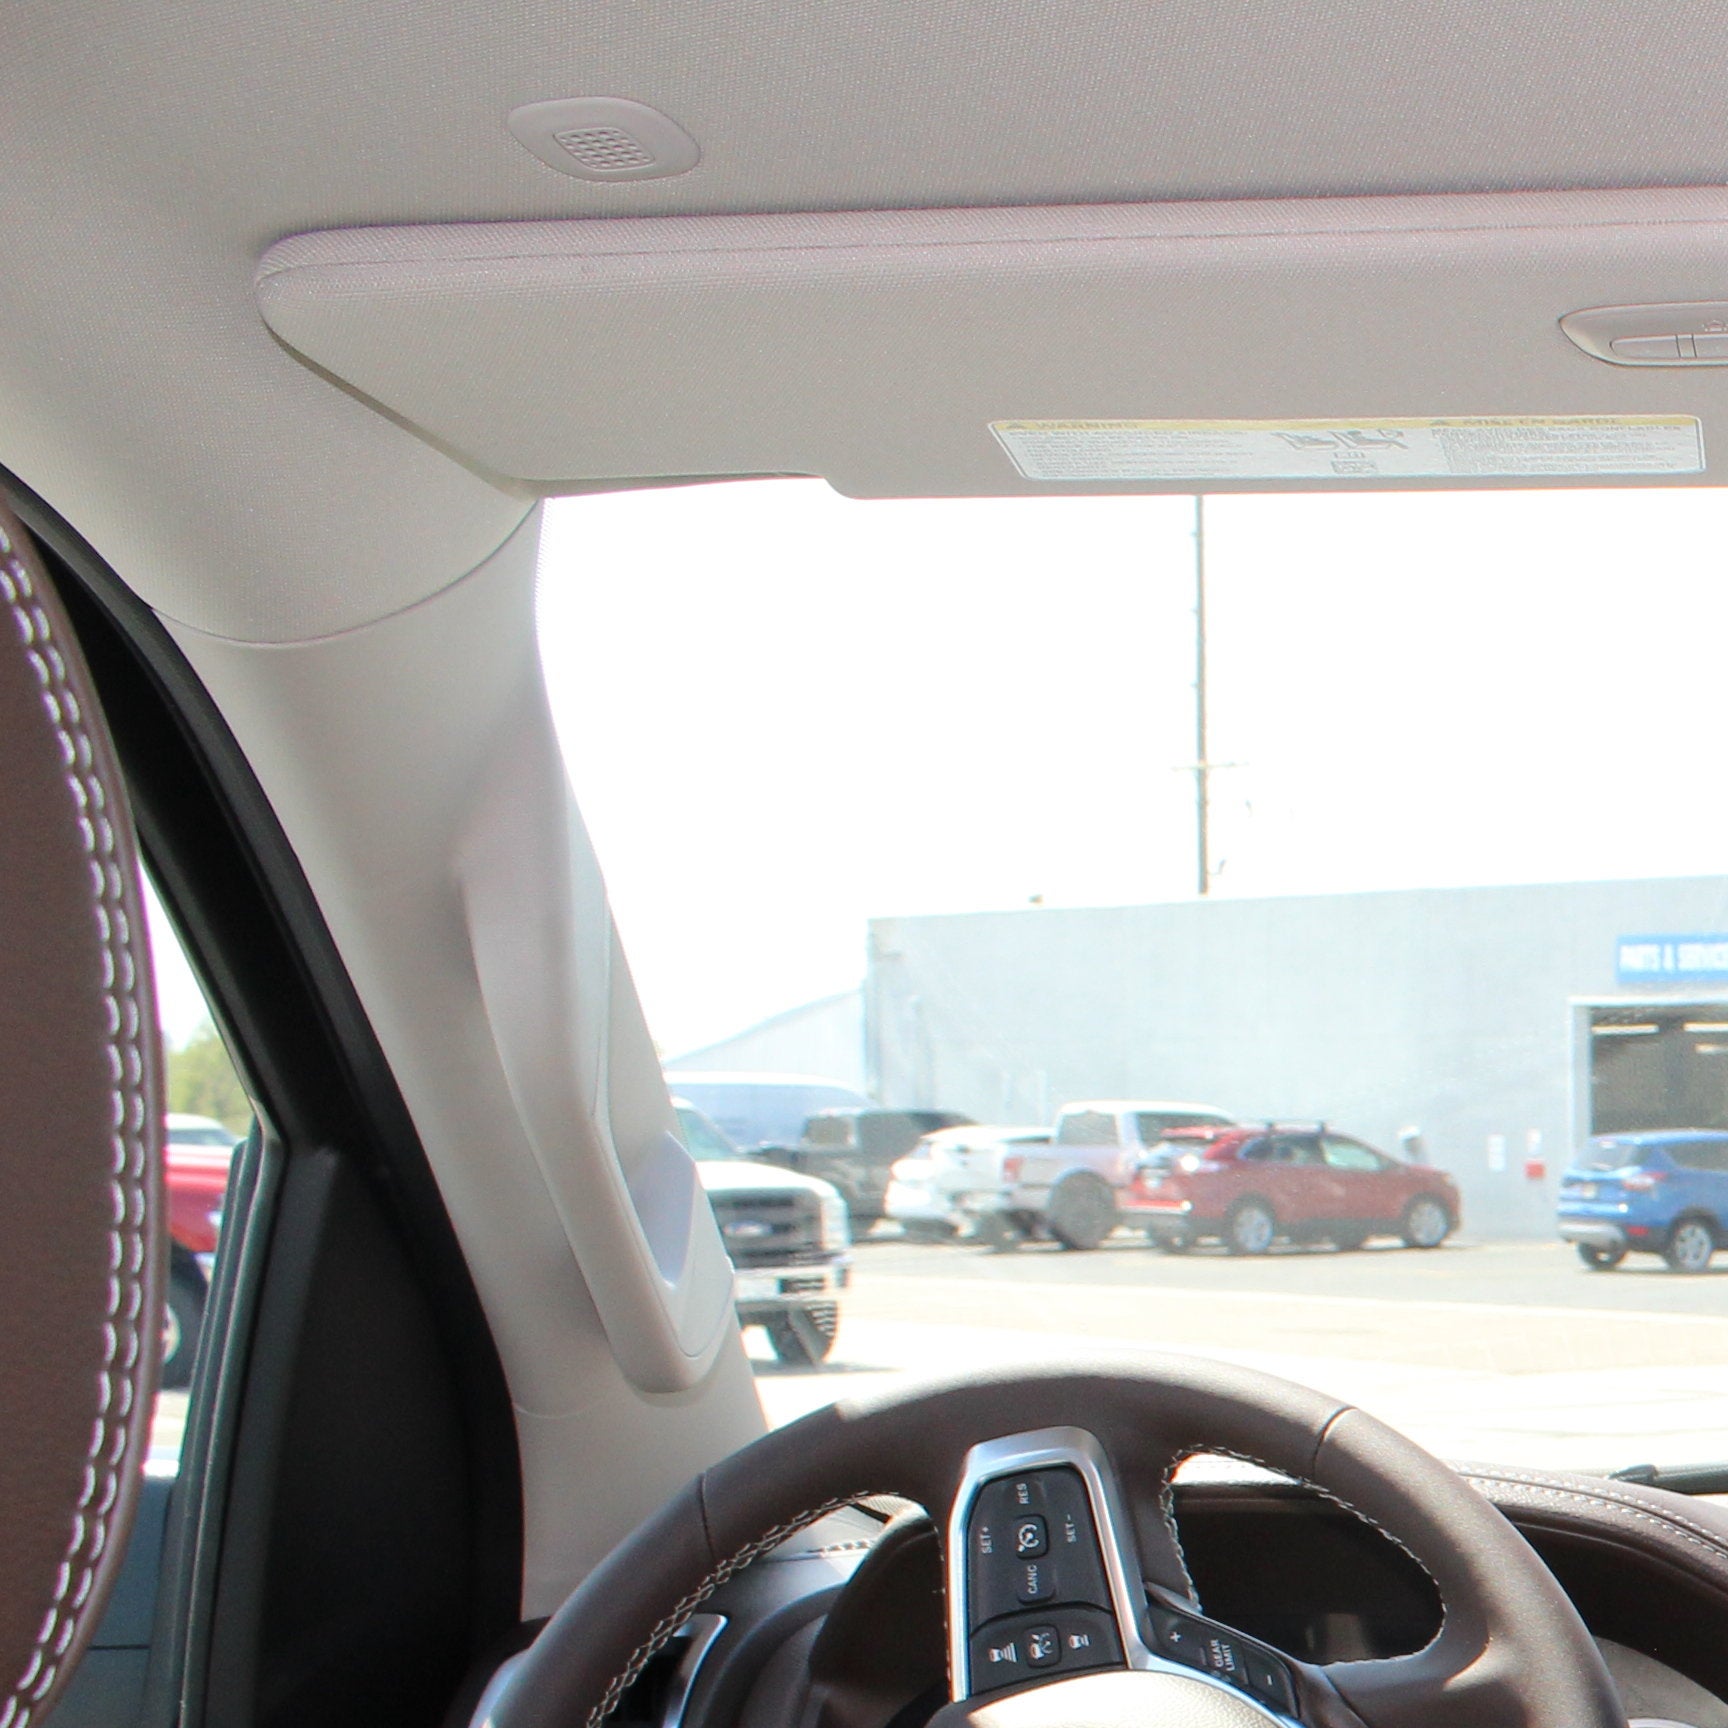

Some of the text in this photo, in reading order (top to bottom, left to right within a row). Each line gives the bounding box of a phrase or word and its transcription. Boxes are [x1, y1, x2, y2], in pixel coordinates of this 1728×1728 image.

[1016, 1483, 1030, 1505] RES
[1027, 1564, 1038, 1595] CANC
[1210, 1639, 1225, 1668] GEAR
[1221, 1644, 1235, 1672] LIMIT
